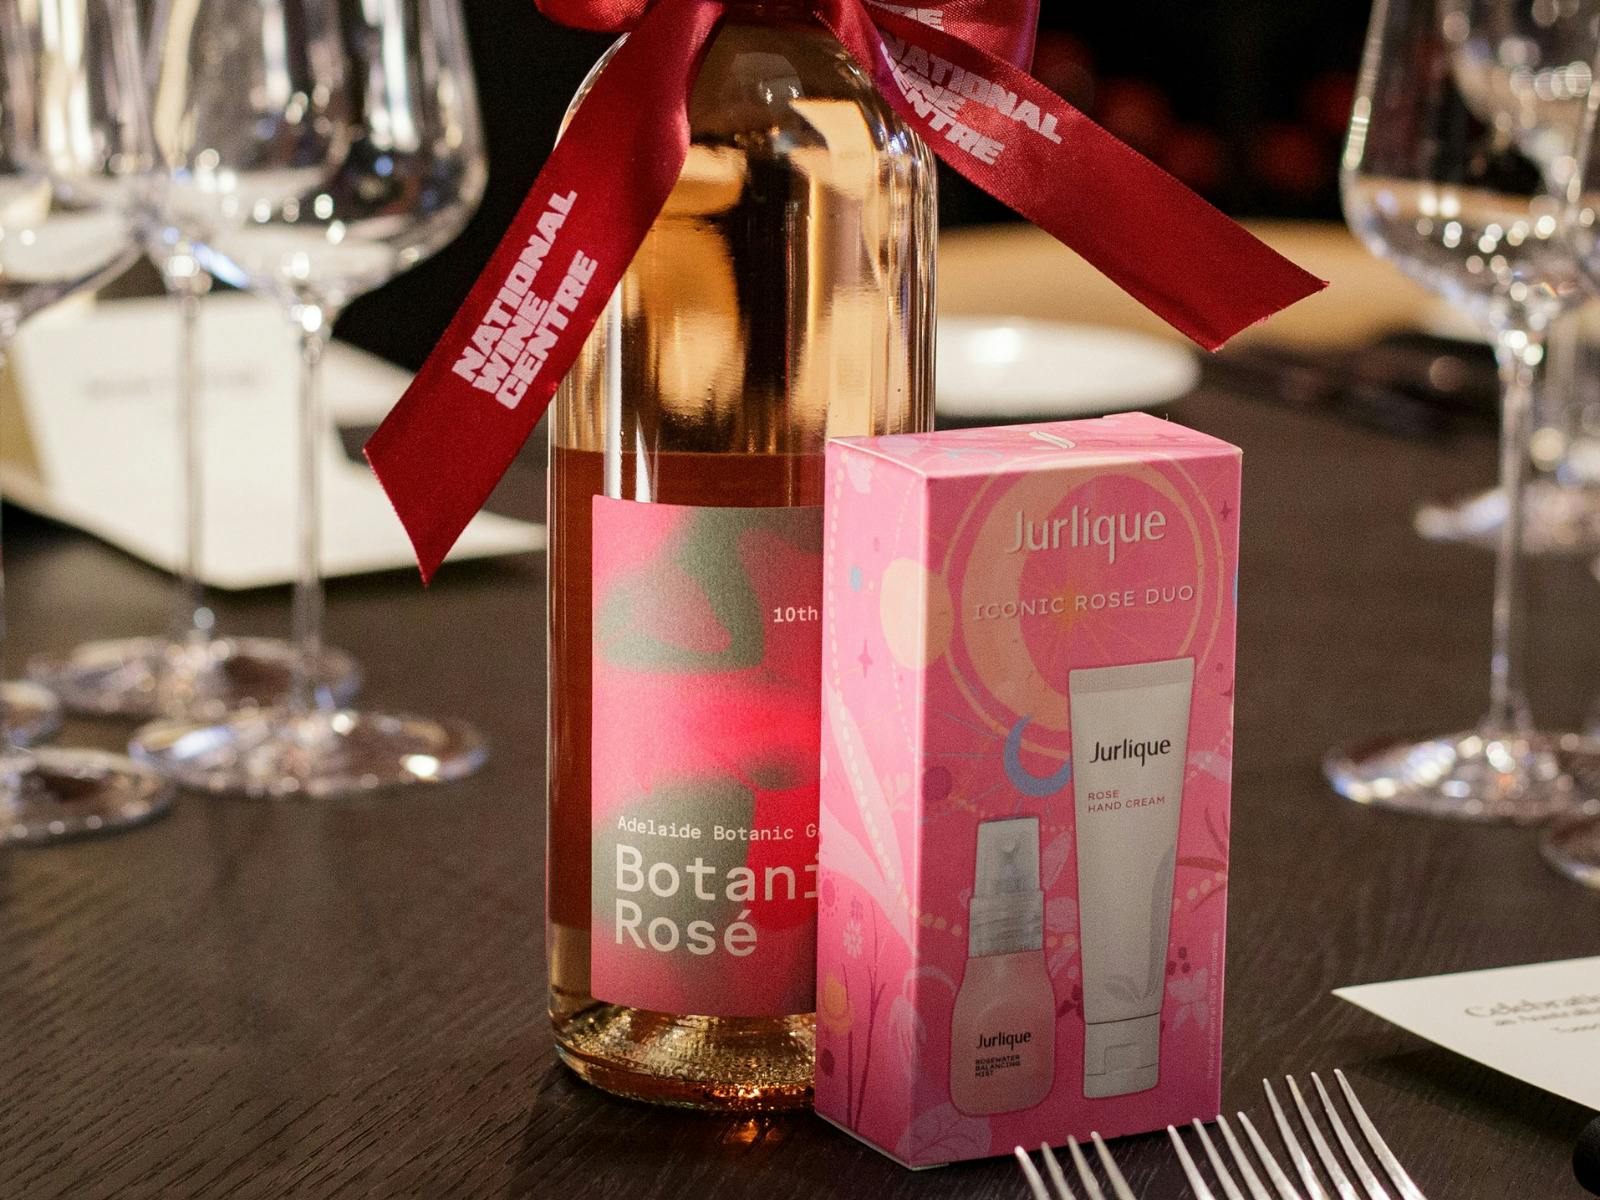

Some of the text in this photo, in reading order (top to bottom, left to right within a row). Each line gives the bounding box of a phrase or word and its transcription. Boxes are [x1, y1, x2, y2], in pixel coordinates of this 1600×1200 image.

[881, 33, 1062, 144] NATIONAL
[452, 190, 577, 382] NATIONAL
[472, 291, 549, 393] WINE
[495, 250, 598, 410] CENTRE
[773, 606, 818, 623] 10th
[973, 585, 1194, 620] ICONIC ROSE DUO
[1088, 790, 1120, 801] ROSE
[1088, 796, 1165, 813] HAND CREAM
[617, 815, 701, 840] Adelaide
[714, 825, 794, 841] Botanic
[616, 898, 757, 957] Rosé
